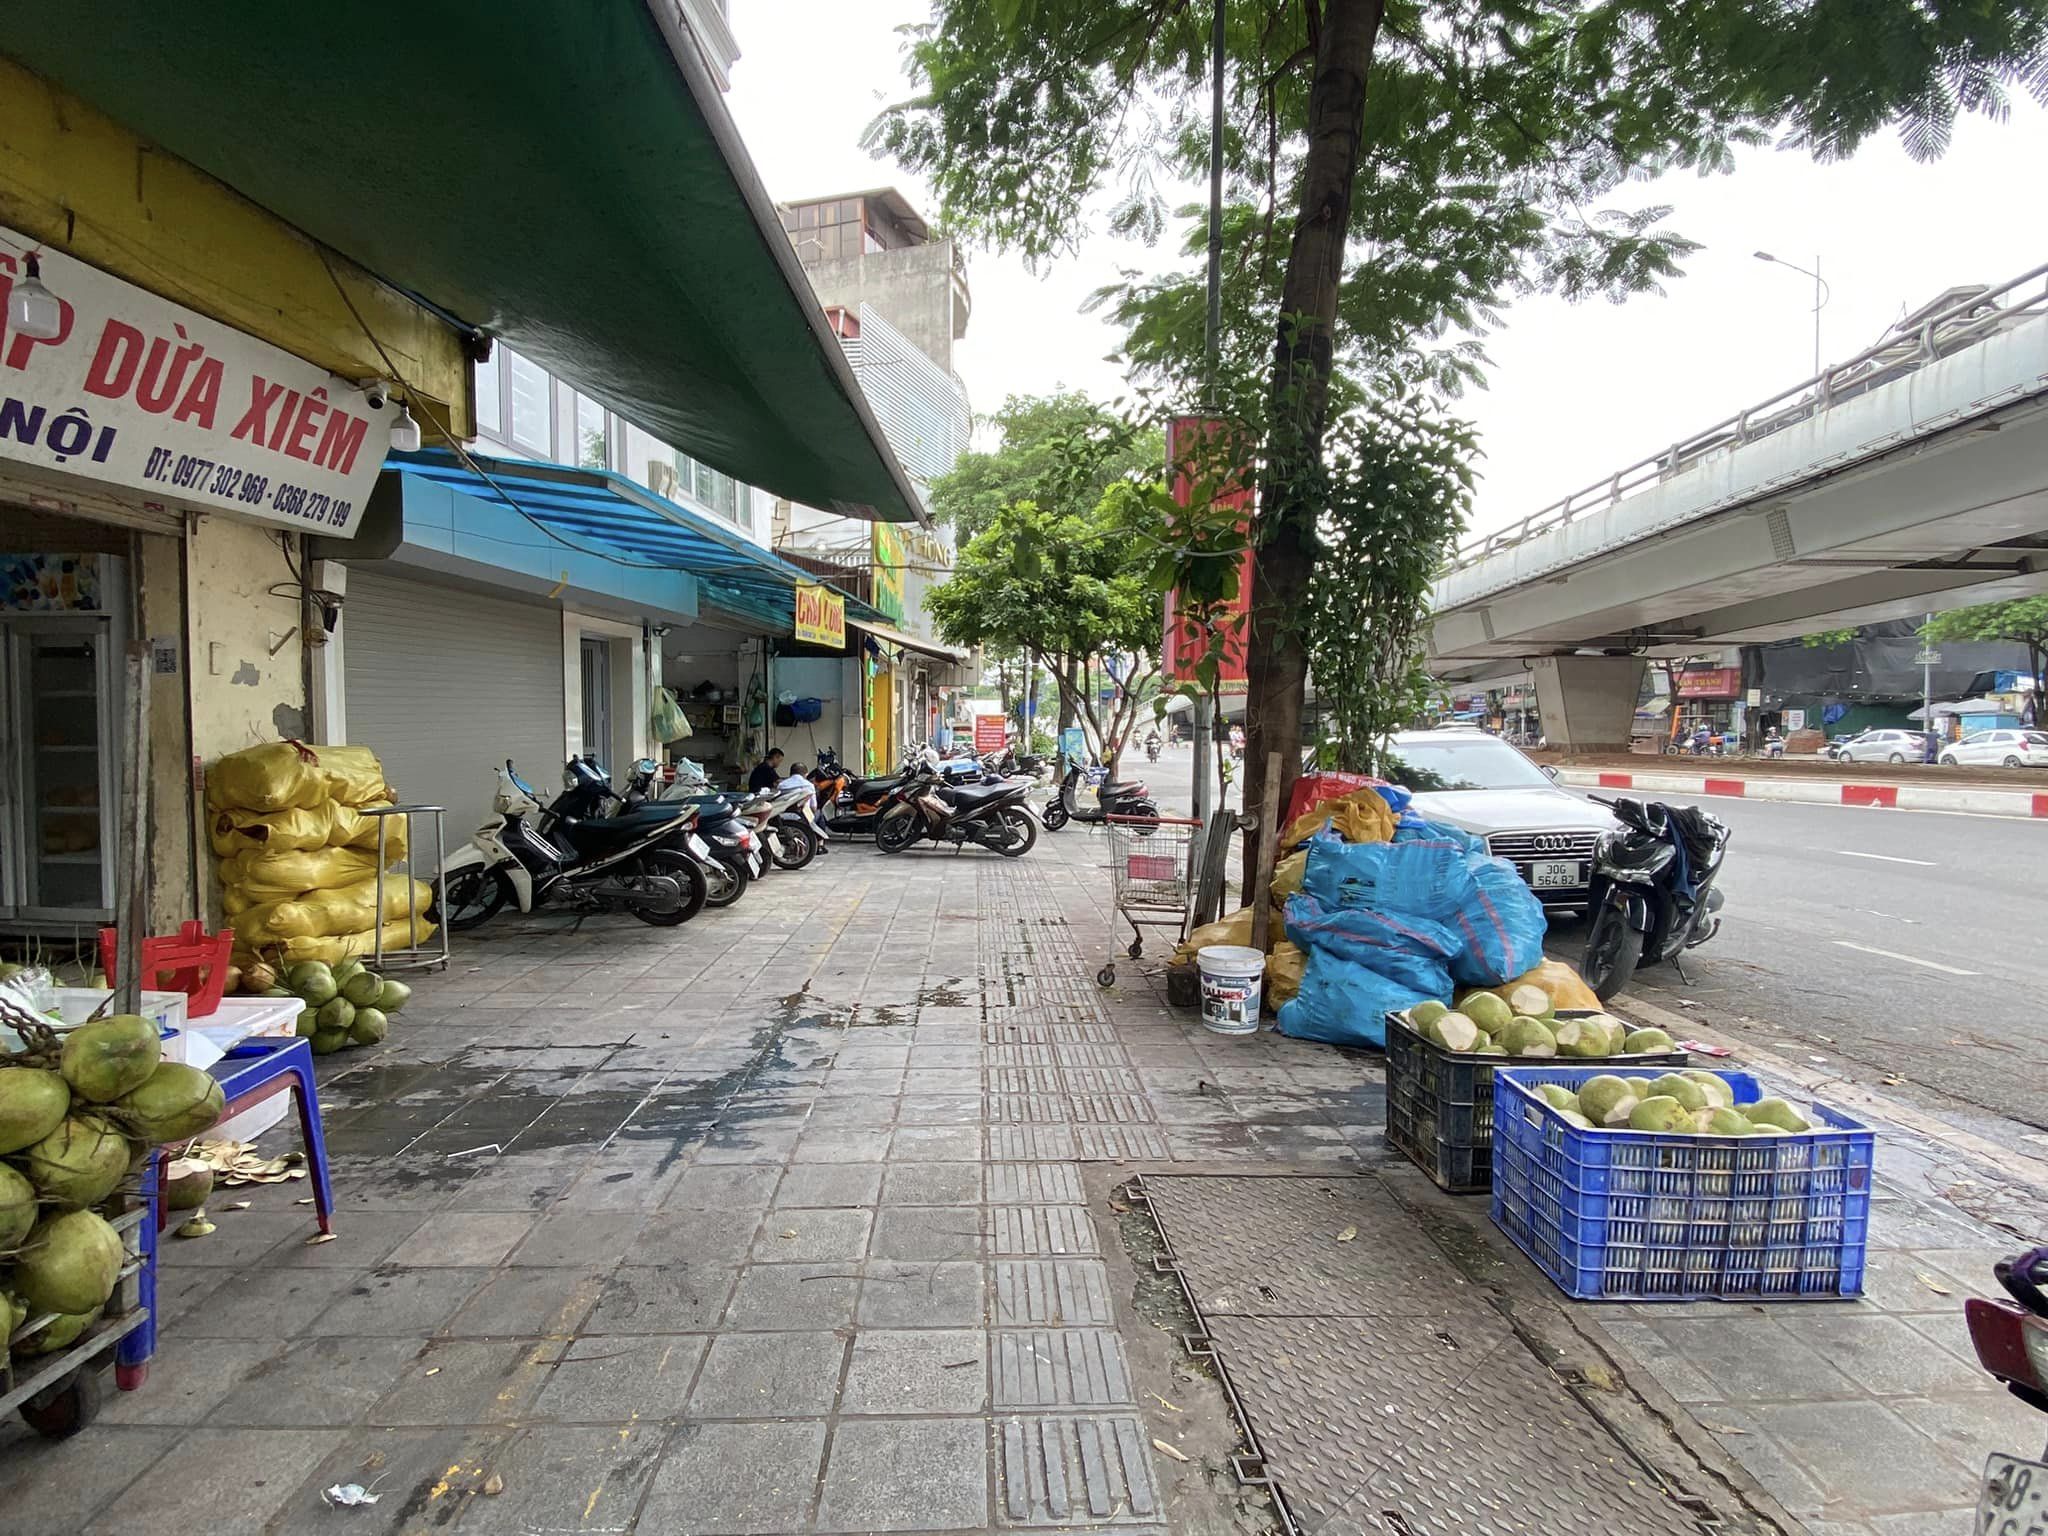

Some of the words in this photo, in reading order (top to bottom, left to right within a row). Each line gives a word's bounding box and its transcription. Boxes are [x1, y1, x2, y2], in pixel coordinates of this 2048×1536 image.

[0, 397, 118, 463] NỘI
[84, 318, 224, 431] DỪA
[230, 375, 369, 476] XIÊM
[144, 446, 173, 482] ĐT:
[171, 454, 215, 491] 0977
[209, 464, 243, 498] 302
[238, 472, 268, 505] 968
[272, 482, 308, 516] 0368
[302, 491, 331, 522] 279
[327, 498, 352, 528] 199
[1546, 864, 1567, 875] 30G
